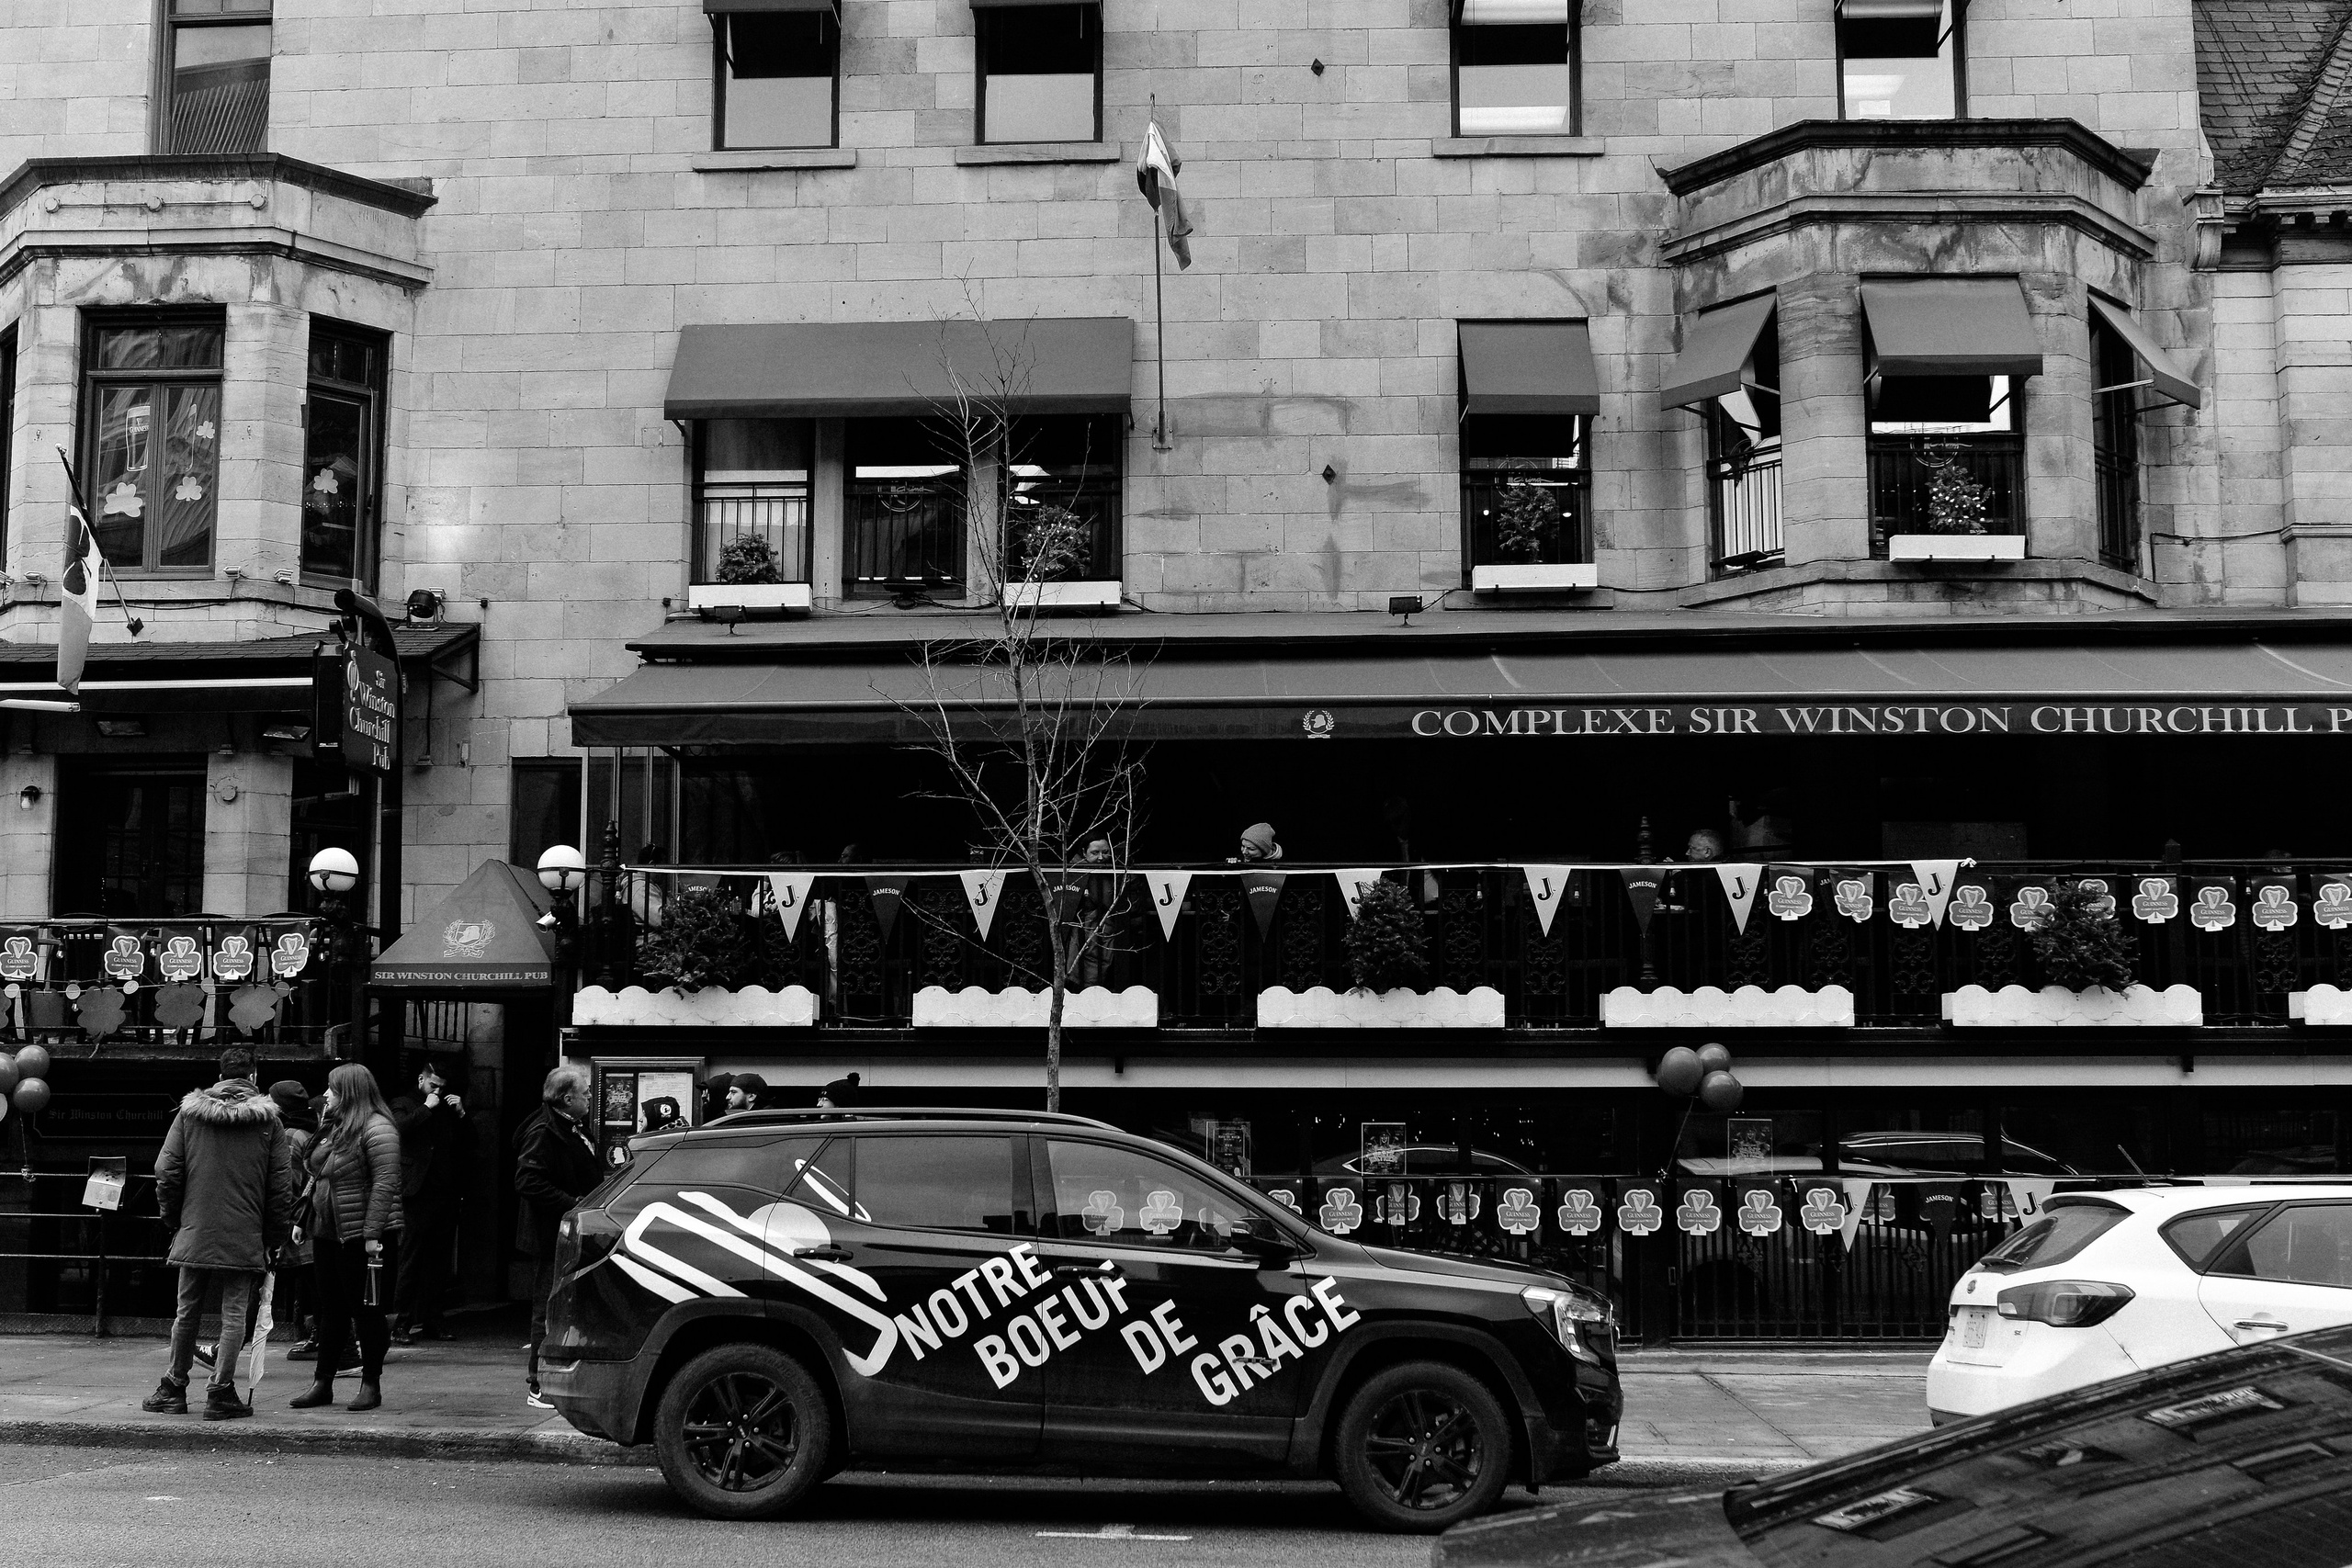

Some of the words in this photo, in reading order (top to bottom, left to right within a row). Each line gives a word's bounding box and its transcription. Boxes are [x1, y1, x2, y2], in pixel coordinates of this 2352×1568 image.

[375, 670, 386, 689] Sir
[358, 681, 395, 718] Winston
[349, 706, 390, 743] Churchill
[1411, 708, 1675, 736] COMPLEXE
[1689, 707, 1761, 734] SIR
[1775, 706, 2012, 733] WINSTON
[2030, 705, 2313, 733] CHURCHILL
[372, 742, 390, 771] Pub
[873, 887, 900, 897] JAMESON
[1250, 886, 1277, 894] JAMESON
[1629, 881, 1657, 889] JAMESON
[375, 971, 395, 980] SIR
[397, 972, 452, 980] WINSTON
[454, 972, 523, 981] CHURCHILL
[524, 971, 548, 980] PUB
[116, 1109, 164, 1122] Churchill
[1925, 1195, 1954, 1203] JAMESON
[894, 1242, 1053, 1361] NOTRE
[973, 1259, 1129, 1389] BOEUF
[1120, 1299, 1198, 1375] DE
[1191, 1275, 1362, 1405] GRÂCE
